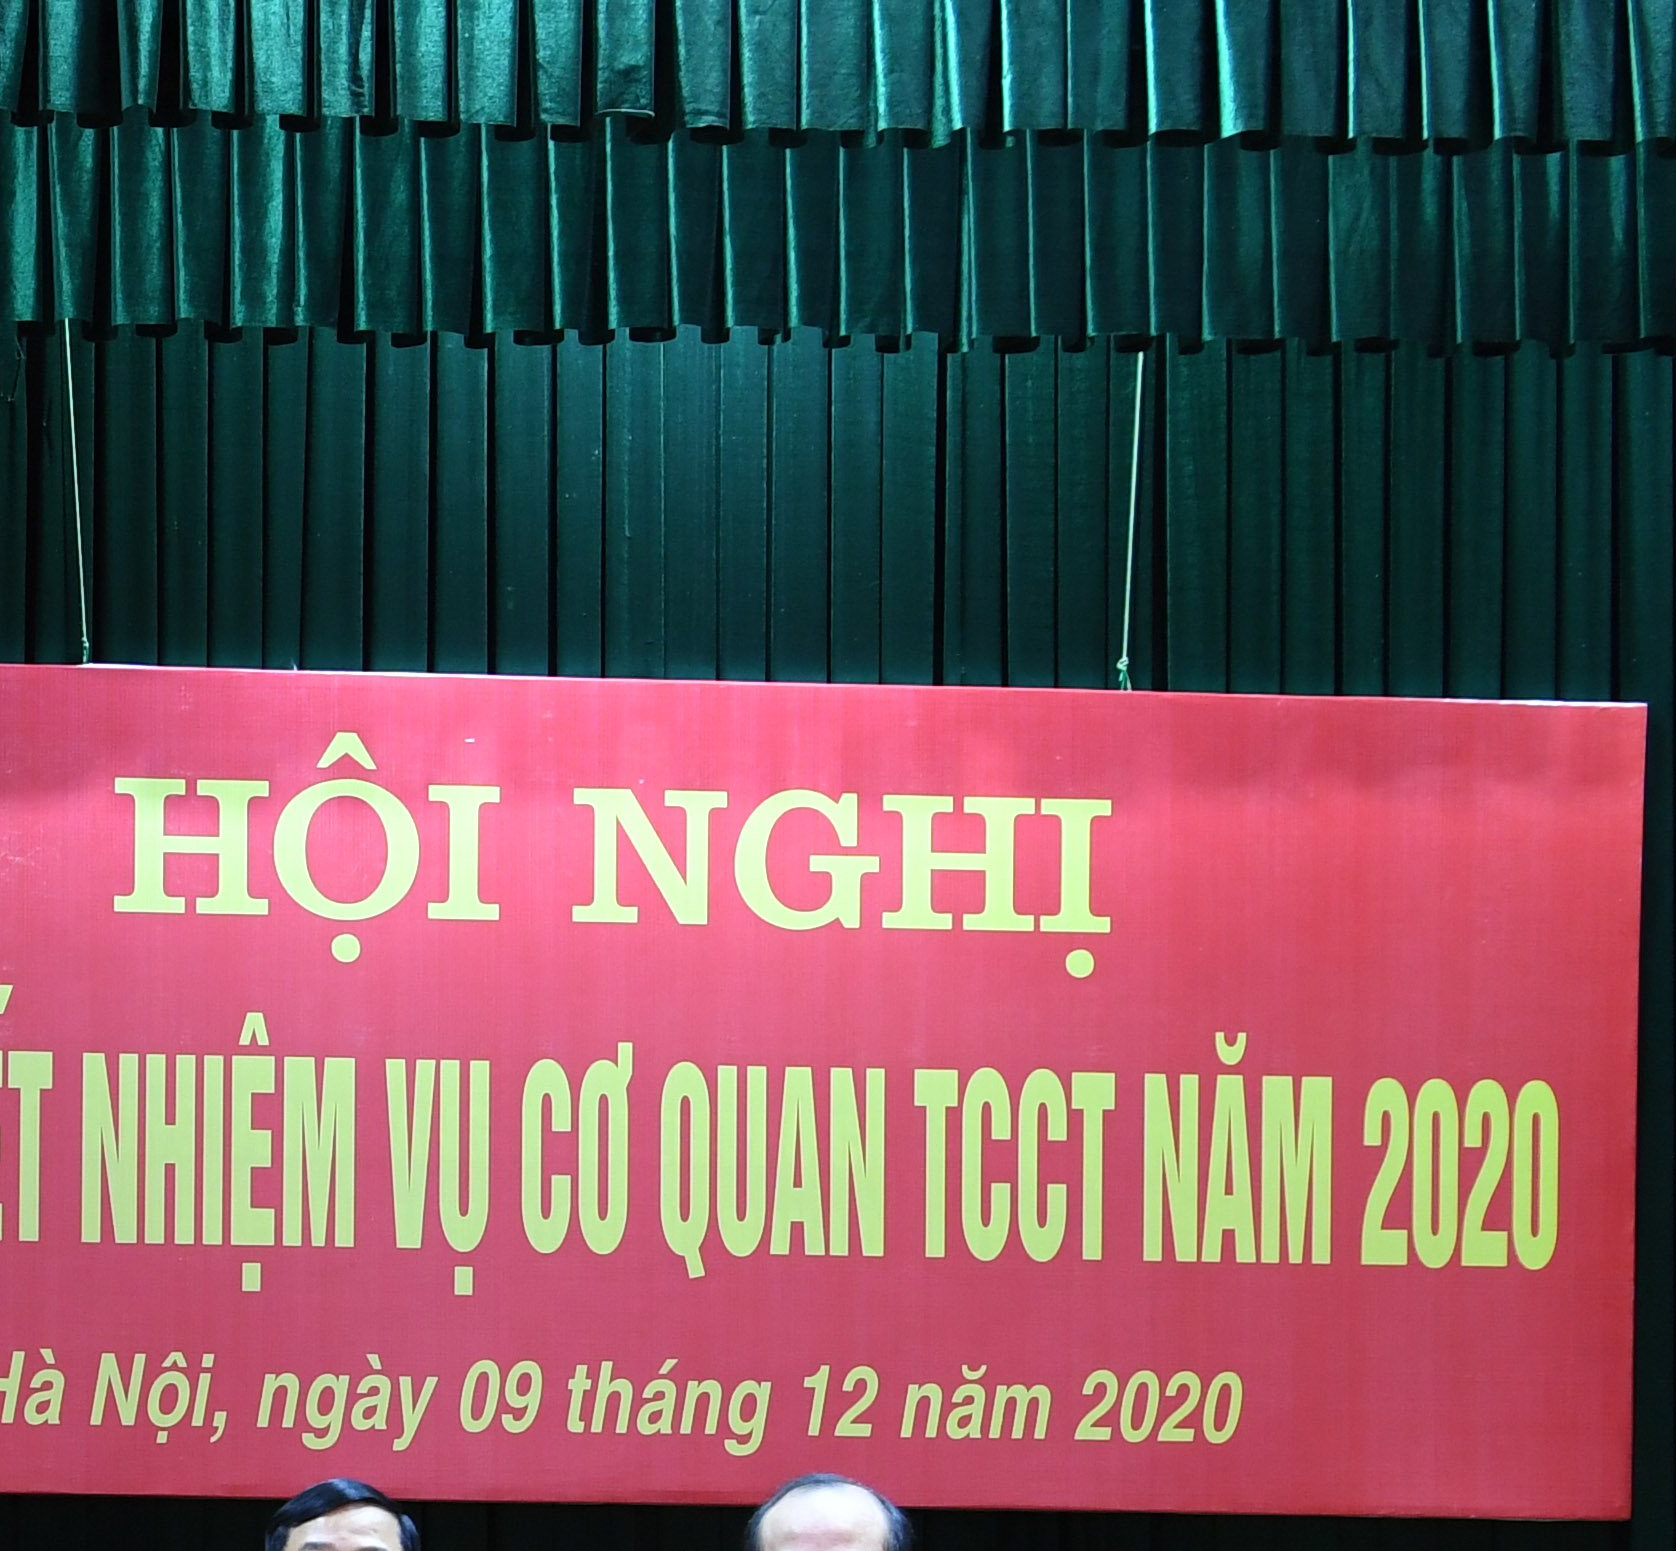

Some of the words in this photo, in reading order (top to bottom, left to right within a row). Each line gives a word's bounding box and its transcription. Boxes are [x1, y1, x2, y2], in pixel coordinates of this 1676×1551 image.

[114, 731, 500, 962] HỘI
[573, 786, 1113, 979] NGHỊ
[81, 1011, 356, 1291] NHIỆM
[386, 1058, 491, 1295] VỤ
[521, 1041, 634, 1255] CƠ
[661, 1061, 886, 1278] QUAN
[914, 1066, 1116, 1262] TCCT
[1143, 1031, 1333, 1265] NĂM
[1360, 1077, 1559, 1271] 2020
[91, 1351, 227, 1443] Nội,
[258, 1354, 437, 1451] ngày
[461, 1359, 543, 1433] 09
[567, 1359, 771, 1456] tháng
[805, 1365, 879, 1437] 12
[901, 1365, 1052, 1440] năm
[1075, 1369, 1243, 1444] 2020
